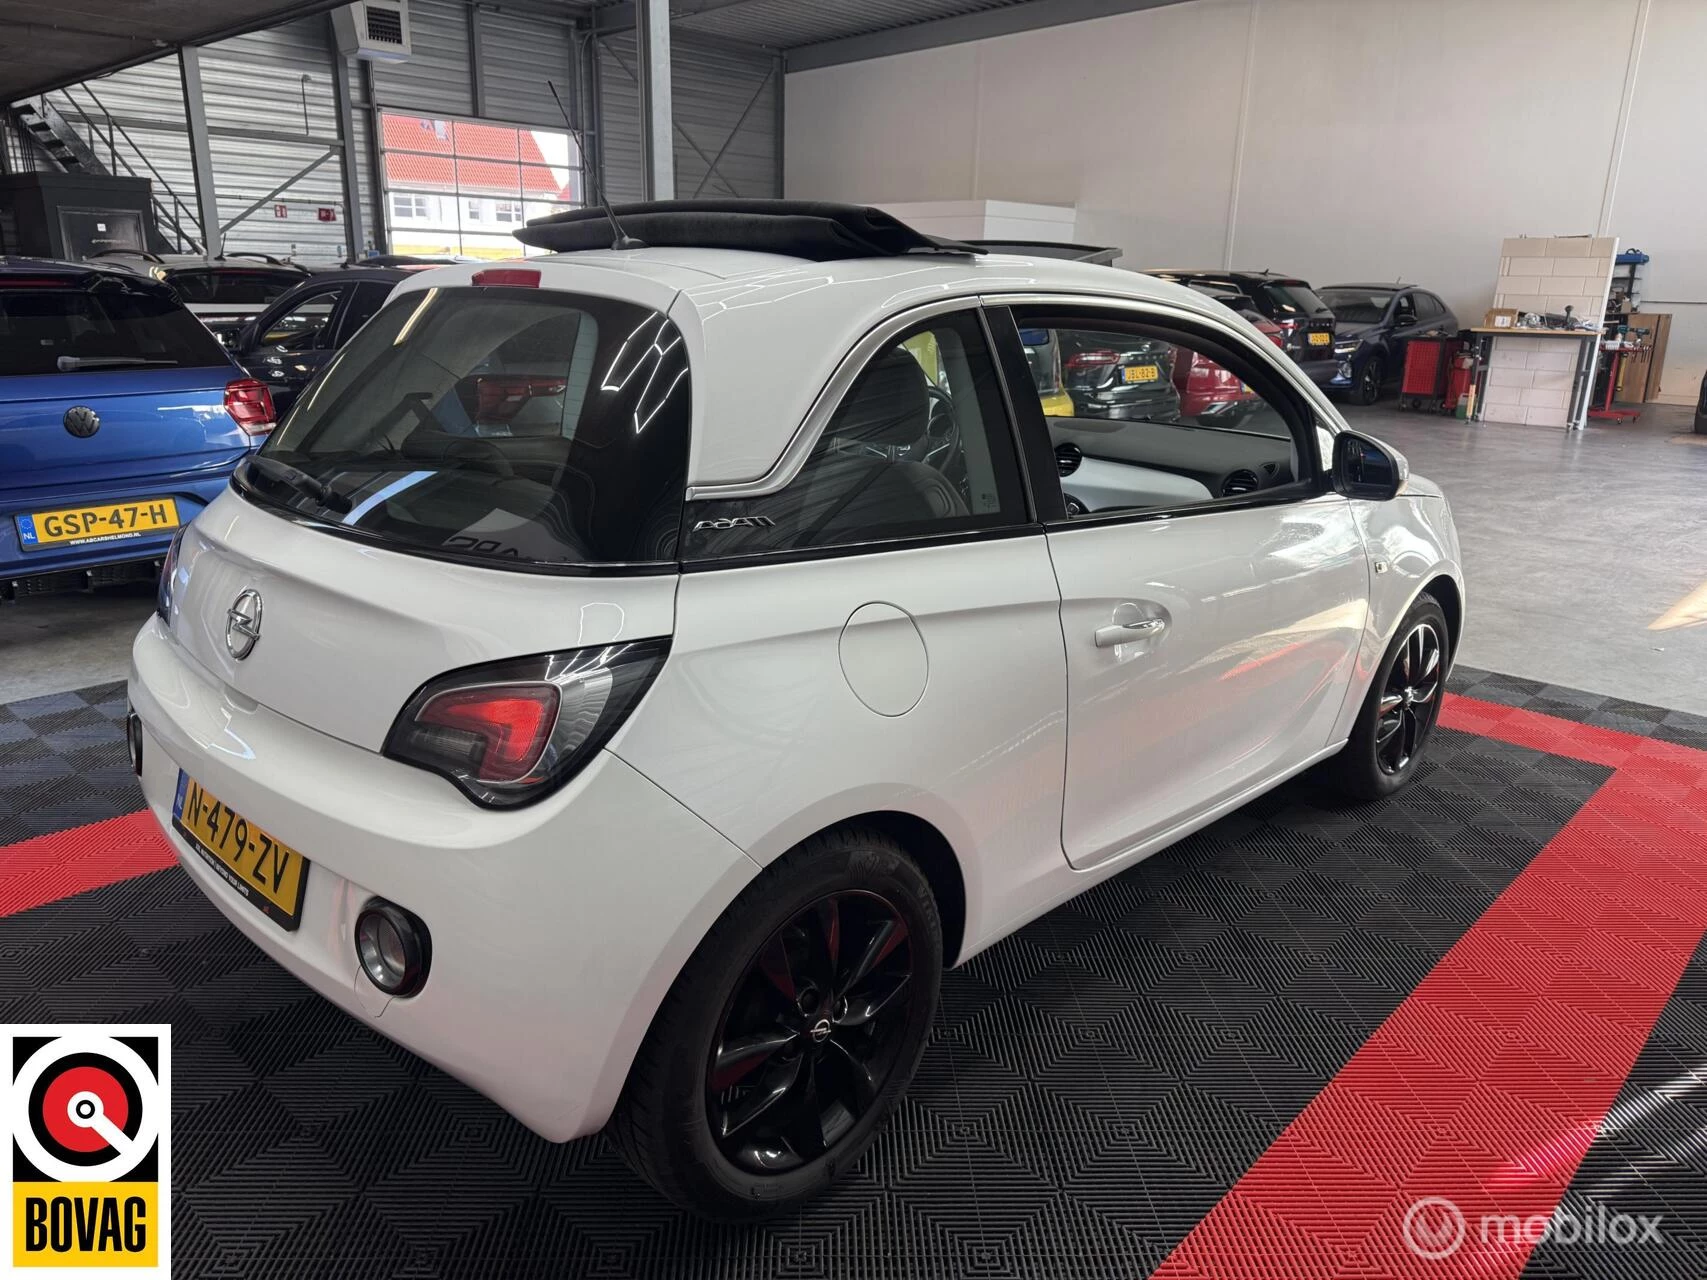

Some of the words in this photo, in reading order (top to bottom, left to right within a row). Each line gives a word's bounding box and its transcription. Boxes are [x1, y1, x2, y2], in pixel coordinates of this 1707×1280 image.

[23, 532, 36, 540] NL
[44, 503, 168, 537] GSP-47-H
[187, 781, 290, 894] N-479-ZV
